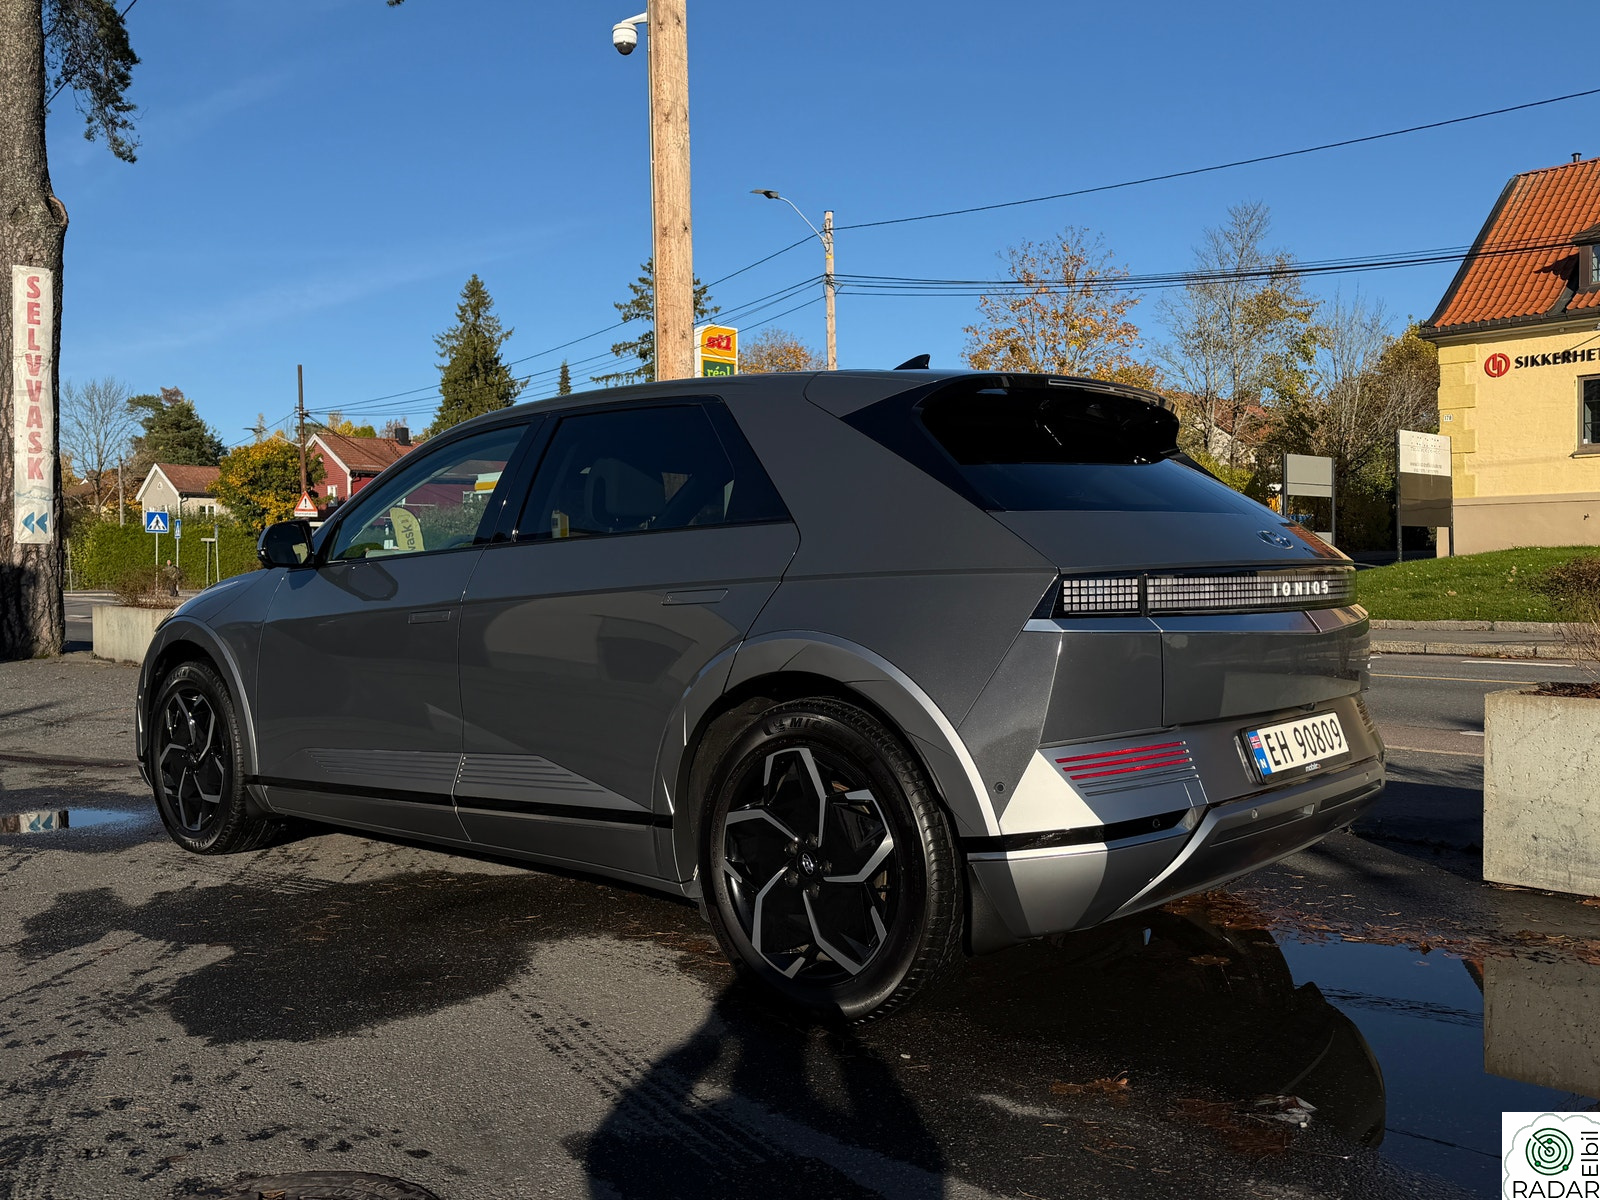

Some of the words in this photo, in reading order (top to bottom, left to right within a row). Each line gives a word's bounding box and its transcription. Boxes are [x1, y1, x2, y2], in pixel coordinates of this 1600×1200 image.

[25, 276, 44, 480] SELVVASK
[1259, 758, 1268, 769] N
[1264, 730, 1294, 766] EH
[1293, 718, 1342, 759] 90809
